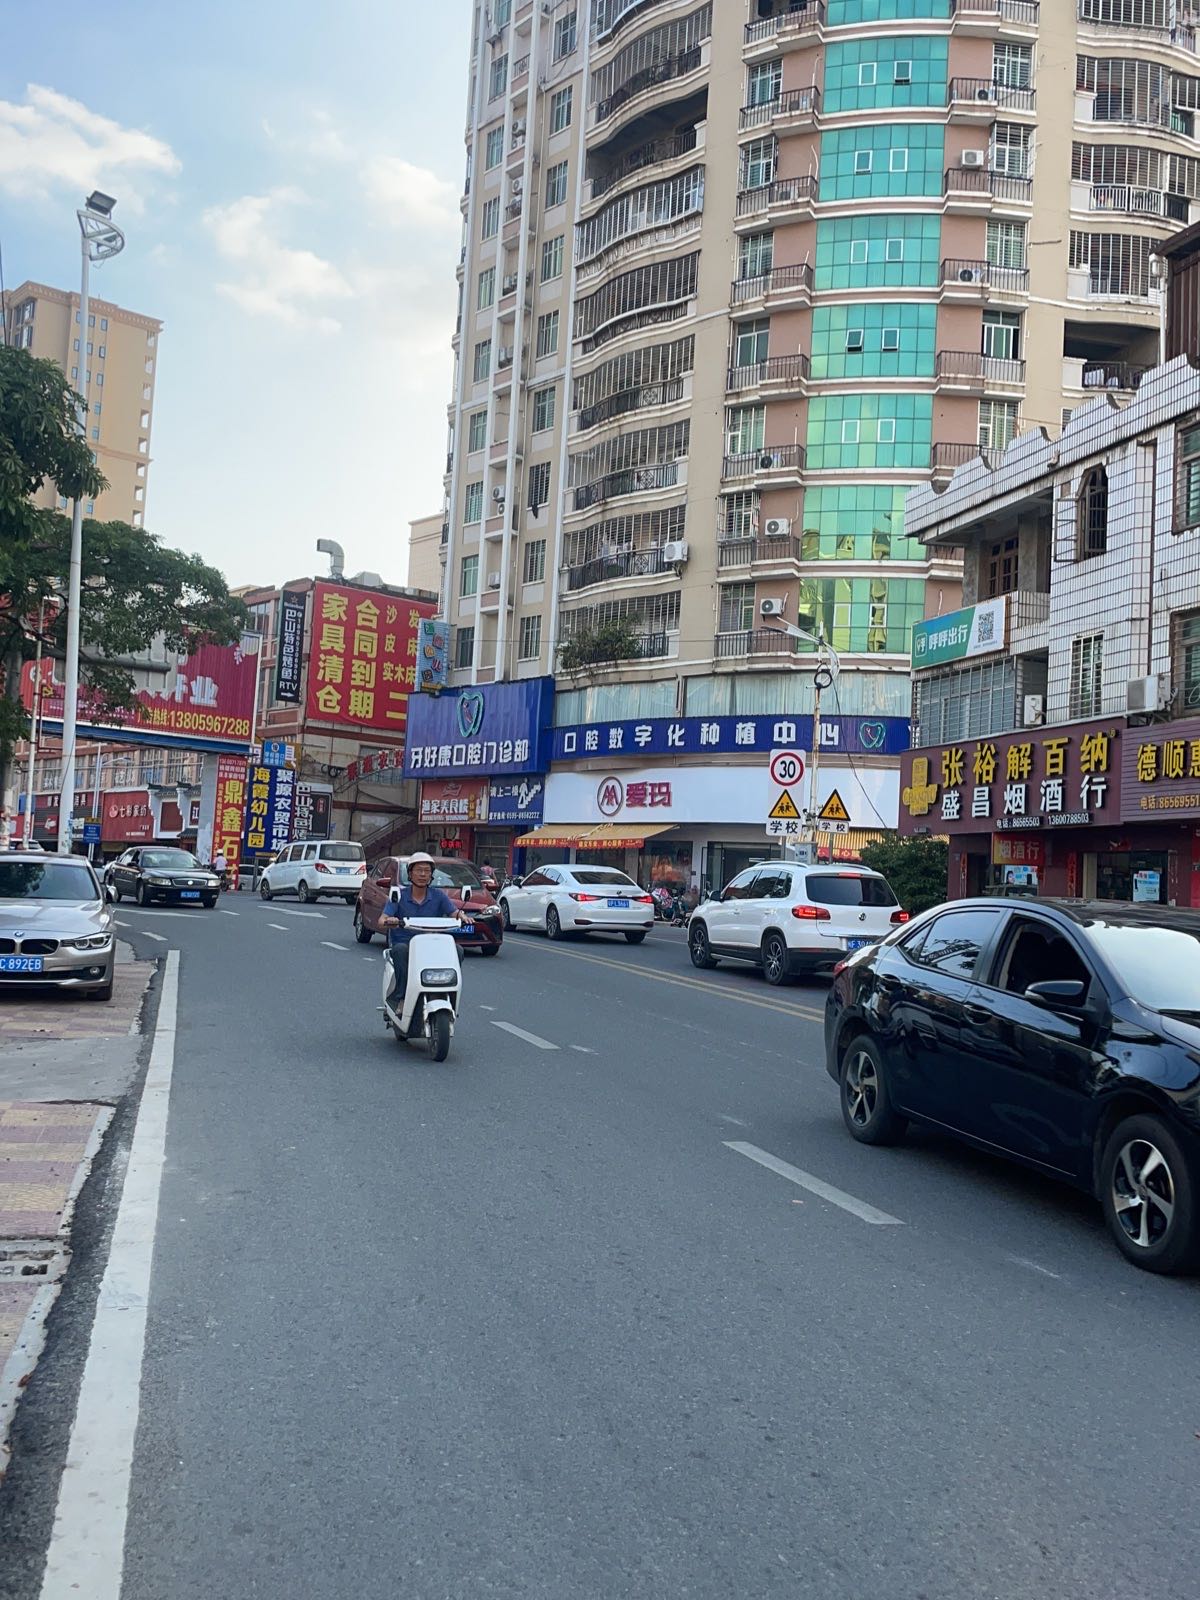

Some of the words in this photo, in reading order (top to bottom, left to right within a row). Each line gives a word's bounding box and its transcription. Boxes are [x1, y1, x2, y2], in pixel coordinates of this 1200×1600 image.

[928, 624, 968, 651] 呼呼出行
[316, 592, 349, 714] 家具清仓
[348, 599, 381, 719] 合同到期
[279, 681, 298, 691] RTV
[382, 660, 416, 685] 实木床
[564, 720, 839, 753] 口腔数字化种植中心
[410, 738, 529, 768] 牙好康口腔门诊部
[941, 731, 1109, 788] 张裕解百纳
[779, 760, 796, 779] 30
[247, 767, 271, 848] 海霞幼儿园
[626, 781, 672, 807] 爱玛
[941, 774, 1107, 820] 盛昌烟酒行
[270, 769, 295, 851] 聚源农贸市场
[996, 817, 1040, 829] 电话:86565503
[1048, 813, 1089, 825] 13600788503
[770, 821, 798, 834] 学校
[822, 822, 845, 832] 学校
